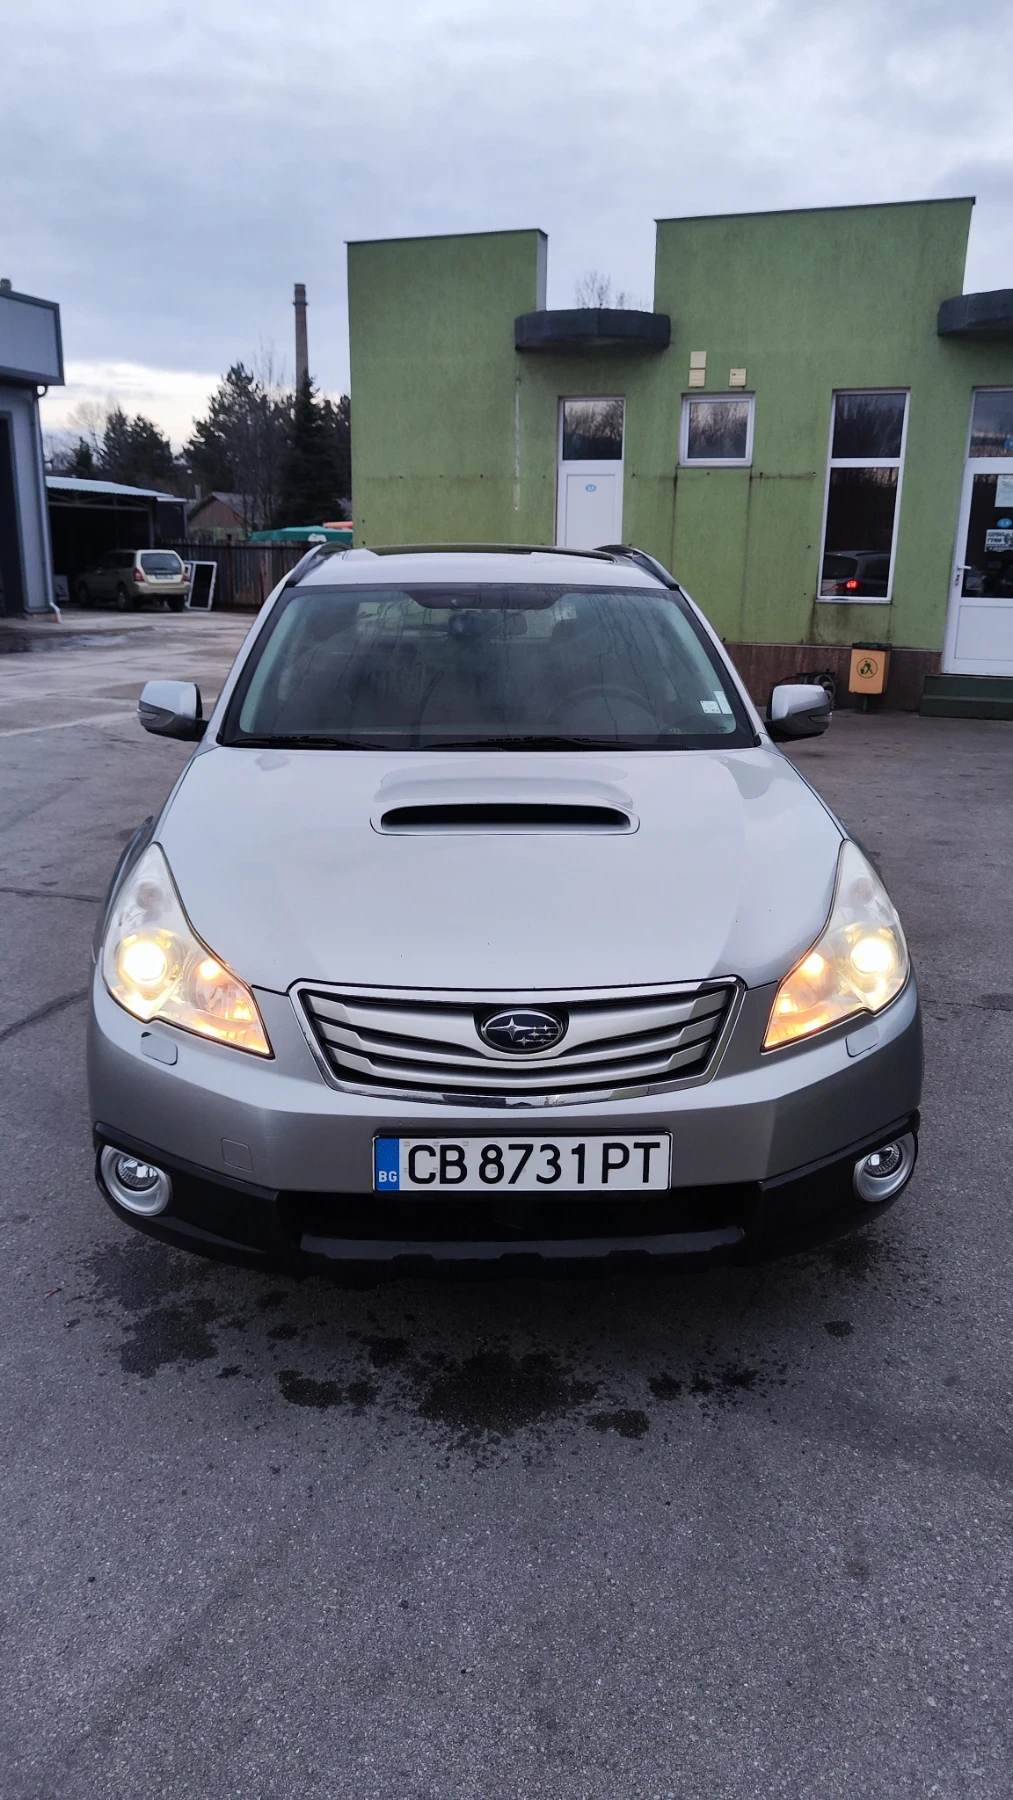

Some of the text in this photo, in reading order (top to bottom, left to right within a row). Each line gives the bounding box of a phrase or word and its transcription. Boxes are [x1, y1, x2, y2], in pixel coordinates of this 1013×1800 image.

[378, 1170, 398, 1182] BG
[408, 1141, 661, 1185] CB 8731 PT
